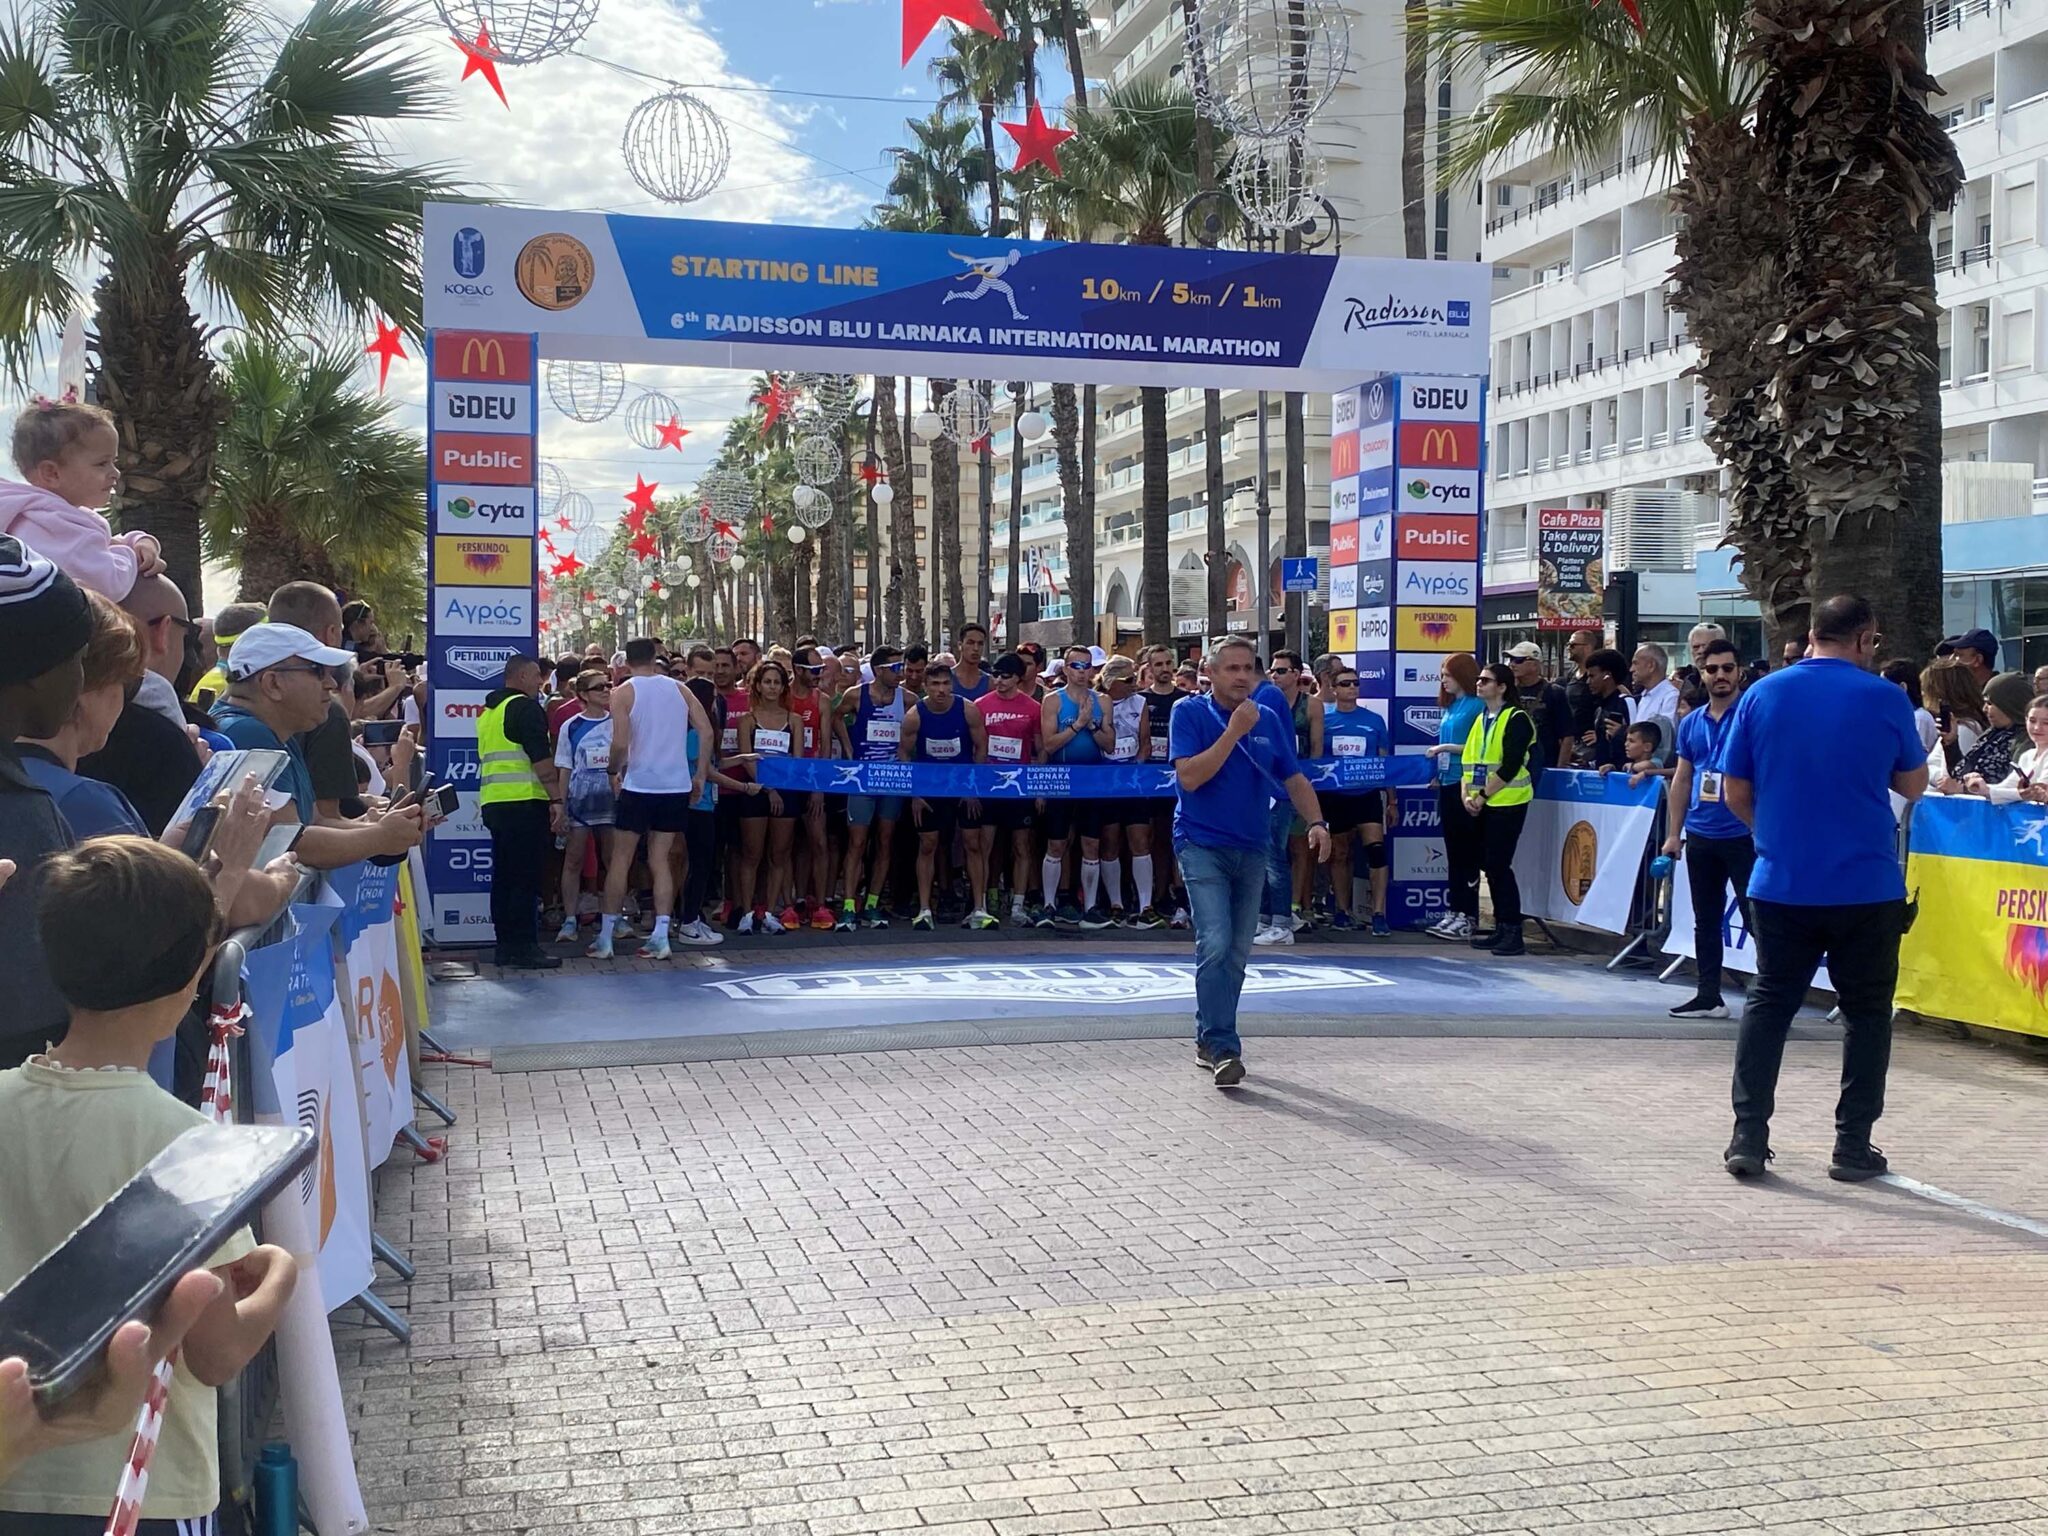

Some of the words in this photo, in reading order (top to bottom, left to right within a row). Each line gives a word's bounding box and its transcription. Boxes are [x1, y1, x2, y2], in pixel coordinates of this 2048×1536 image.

[671, 255, 809, 283] STARTING
[818, 264, 879, 287] LINE
[1082, 278, 1141, 302] 10km
[1172, 282, 1211, 305] 5km
[1242, 286, 1282, 309] 1km
[1344, 293, 1445, 335] Radisson
[1448, 310, 1470, 319] BLU
[671, 311, 700, 330] 6th
[705, 314, 822, 336] RADISSON
[828, 320, 872, 339] BLU
[878, 322, 983, 345] LARNAKA
[988, 328, 1158, 353] INTERNATIONAL
[1163, 336, 1281, 358] MARATHON
[1406, 330, 1431, 338] HOTEL
[444, 449, 523, 469] Public
[1432, 483, 1470, 503] cyta
[478, 502, 525, 523] cyta
[1541, 512, 1568, 526] Cafe
[1570, 513, 1600, 527] Plaza
[1332, 535, 1356, 553] Public
[1405, 529, 1470, 546] Public
[1542, 530, 1568, 542] Take
[1569, 530, 1601, 544] Away
[456, 541, 511, 555] PERSKINDOL
[1542, 541, 1551, 552] &
[1553, 542, 1600, 556] Delivery
[1557, 556, 1585, 565] Platters
[1405, 571, 1469, 596] Αγρός
[1560, 580, 1581, 588] Pasta
[445, 598, 522, 626] Αγρός
[1414, 612, 1458, 623] PERSKINDOL
[1419, 674, 1441, 682] ASFA
[1411, 710, 1444, 720] PETROL
[868, 769, 913, 778] LARNAKA
[1343, 763, 1385, 771] LARNAKA
[1027, 772, 1070, 780] LARNAKA
[867, 781, 913, 789] MARATHON
[1402, 811, 1442, 827] KPM
[455, 823, 488, 832] SKYL
[448, 847, 493, 870] as
[473, 871, 492, 882] lea
[1411, 866, 1448, 874] SKYLIN
[786, 966, 1326, 991] PETROLIA
